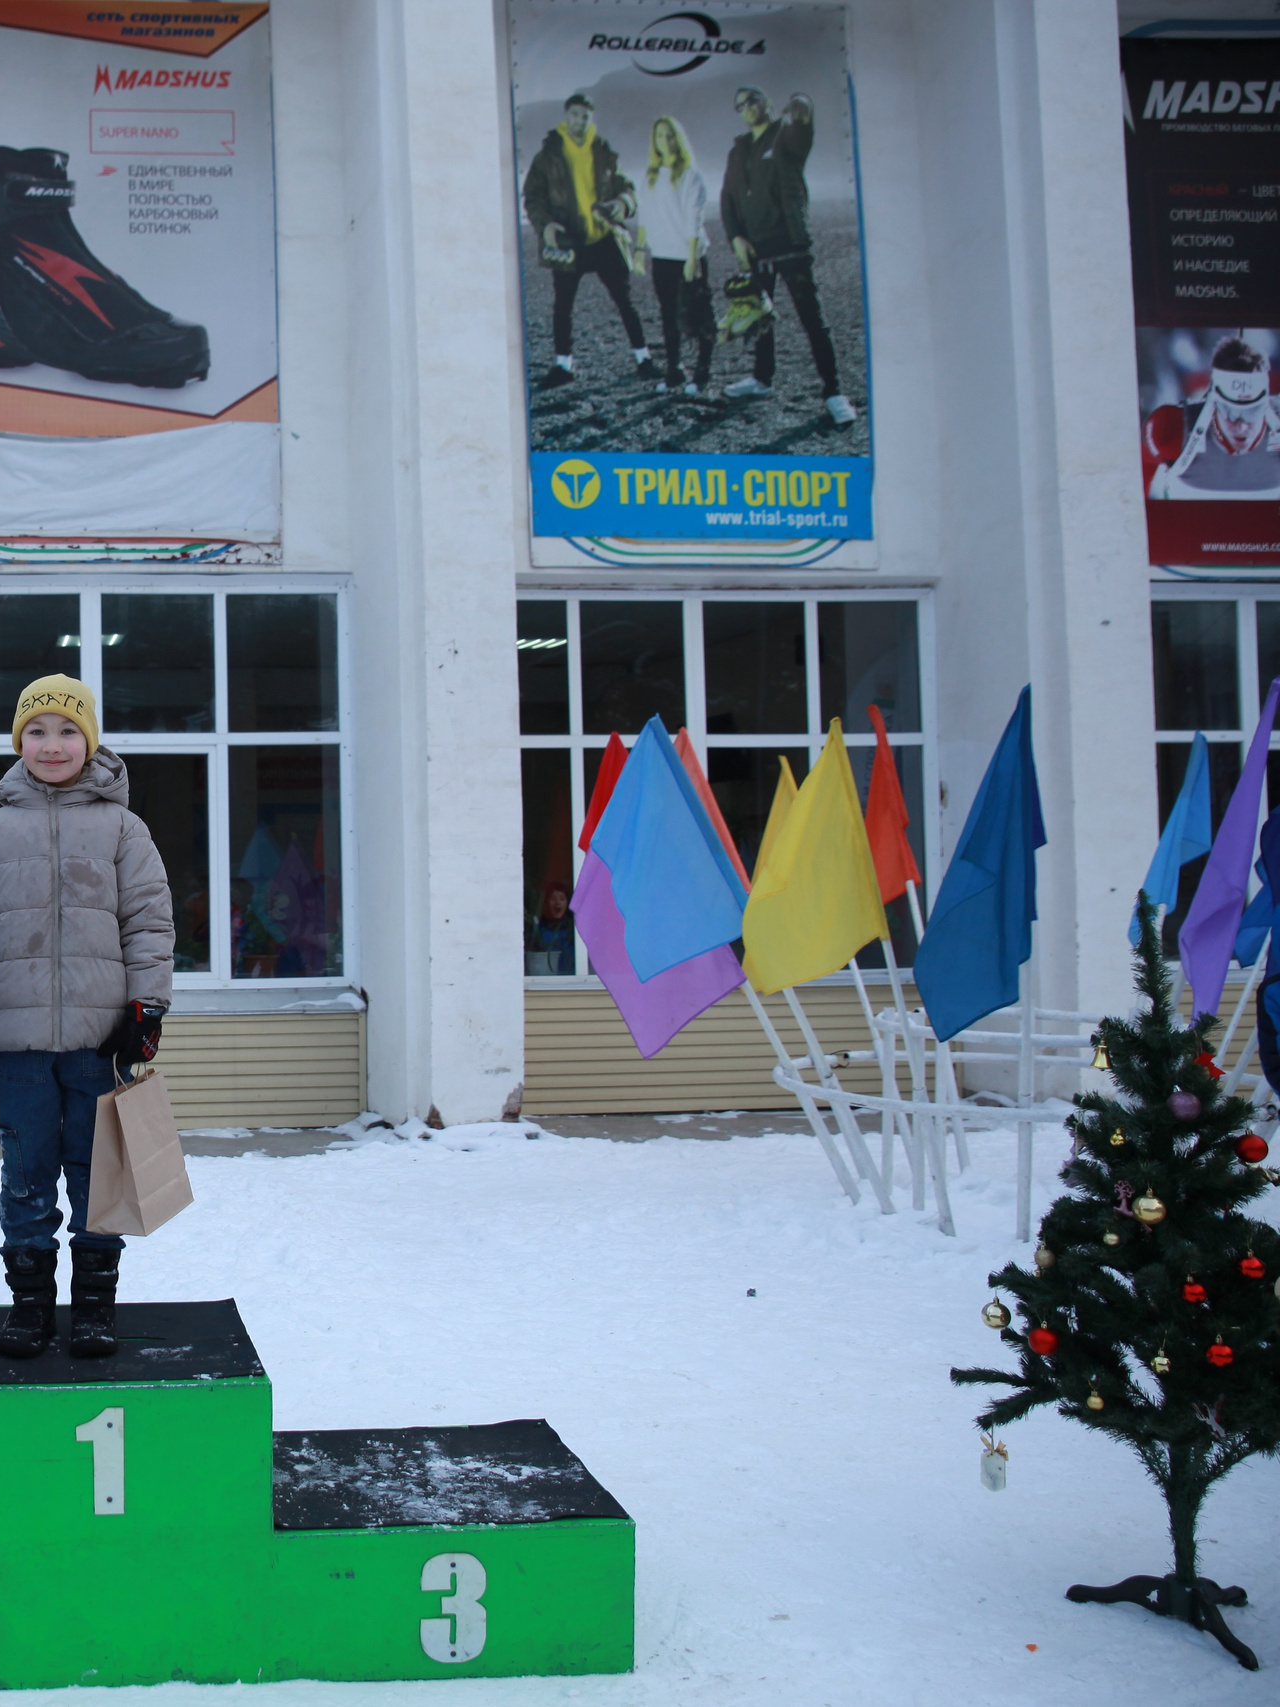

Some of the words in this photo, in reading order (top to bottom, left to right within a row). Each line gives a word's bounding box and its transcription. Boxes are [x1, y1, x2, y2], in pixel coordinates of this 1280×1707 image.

[86, 12, 125, 23] сеть
[130, 12, 240, 26] спортивных
[120, 26, 216, 38] магазинов
[114, 69, 232, 90] MADSHUS
[99, 127, 138, 138] SUPER
[141, 127, 179, 139] NANO
[128, 164, 233, 178] ЕДИНСТВЕННЫЙ
[129, 180, 137, 191] В
[140, 180, 175, 191] МИРЕ
[128, 194, 213, 206] ПОЛНОСТЬЮ
[129, 207, 219, 220] КАРБОНОВЫЙ
[1170, 208, 1278, 223] ОПРЕДЕЛЯЮЩИЙ
[129, 222, 191, 235] БОТИНОК
[1172, 234, 1234, 248] ИСТОРИЮ
[1173, 260, 1184, 272] И
[1186, 260, 1250, 273] НАСЛЕДИЕ
[706, 510, 849, 528] www.trial-sport.ru
[75, 1406, 125, 1516] 1
[419, 1552, 487, 1663] 3
